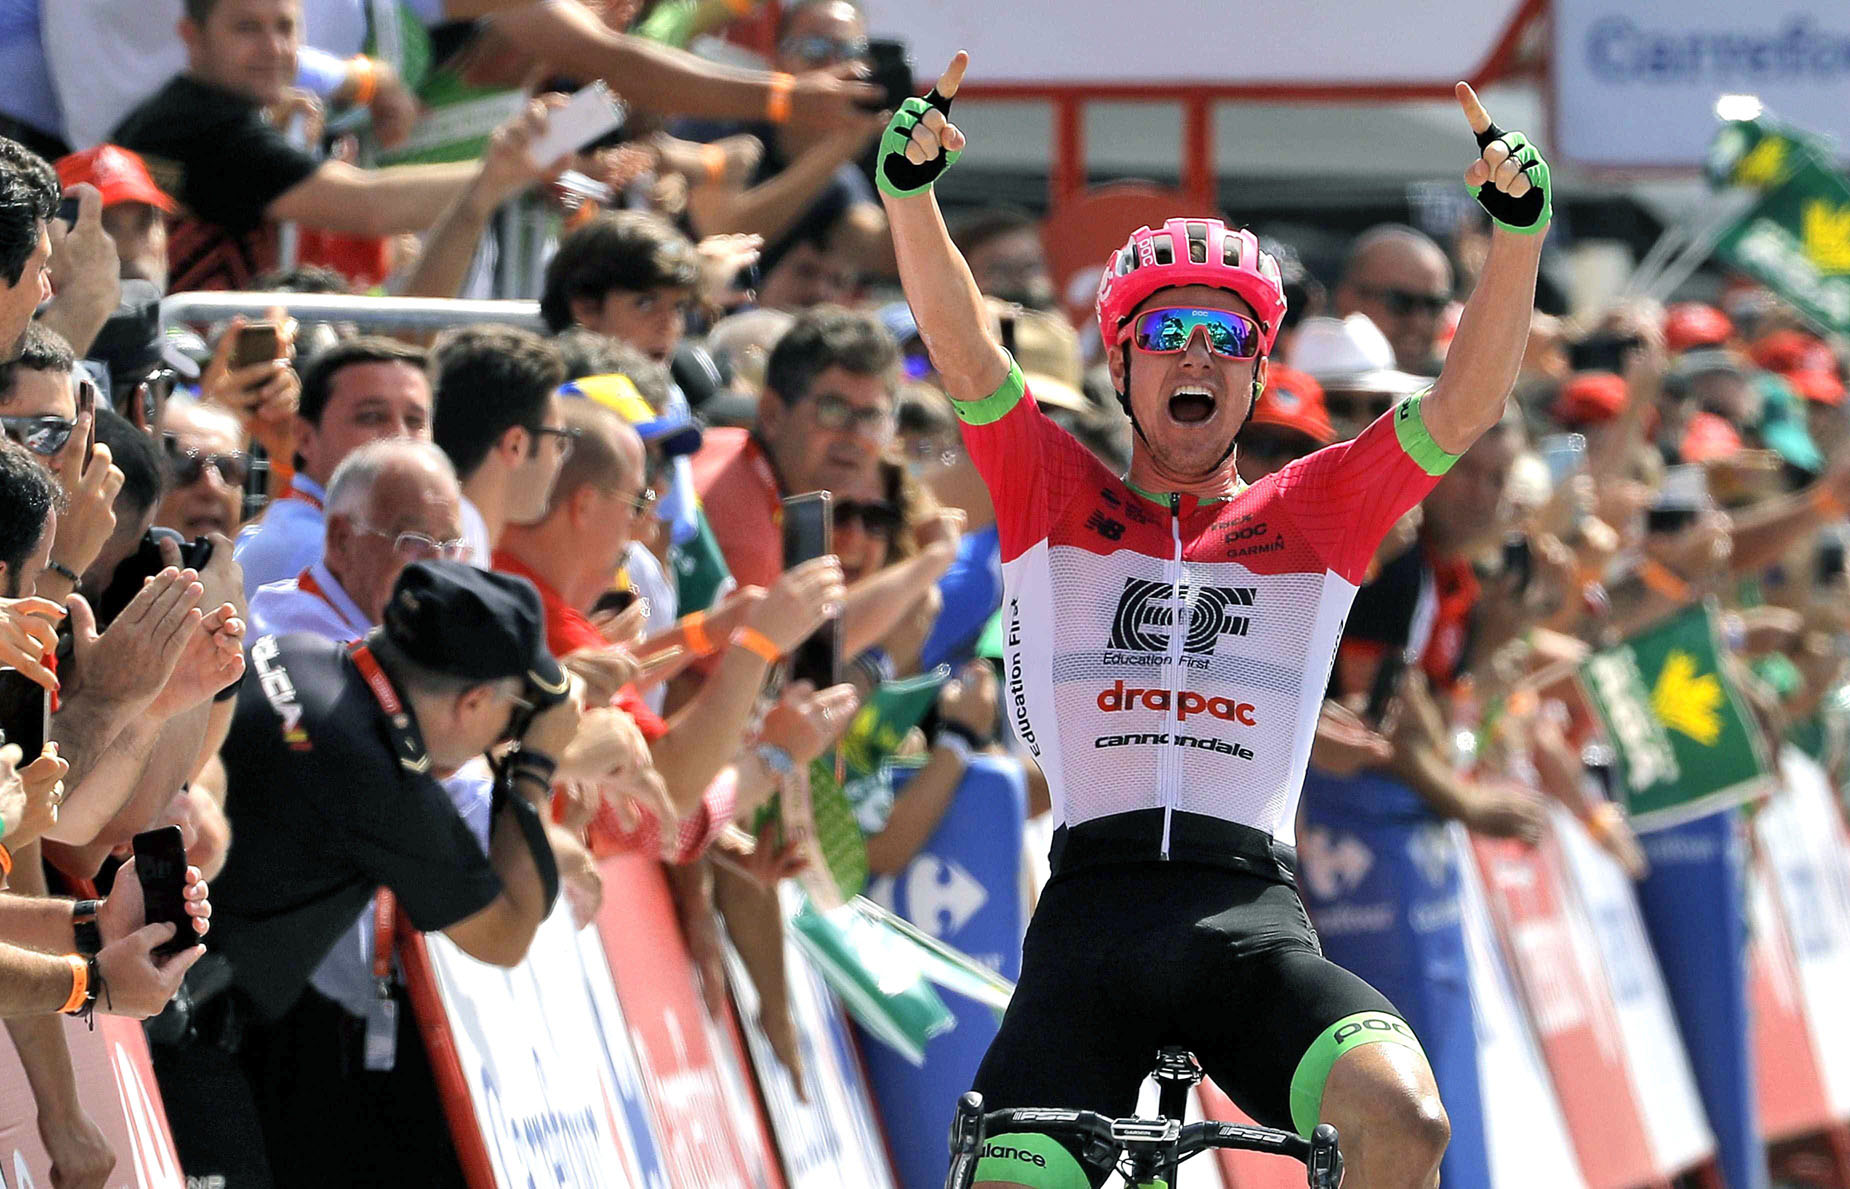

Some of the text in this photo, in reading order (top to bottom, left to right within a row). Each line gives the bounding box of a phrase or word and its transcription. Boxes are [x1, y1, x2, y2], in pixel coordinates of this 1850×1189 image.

[1226, 540, 1285, 558] GARMIN
[1103, 652, 1210, 670] Education First
[1009, 652, 1041, 757] Education
[1096, 679, 1257, 727] drapac
[1095, 733, 1254, 761] cannondale
